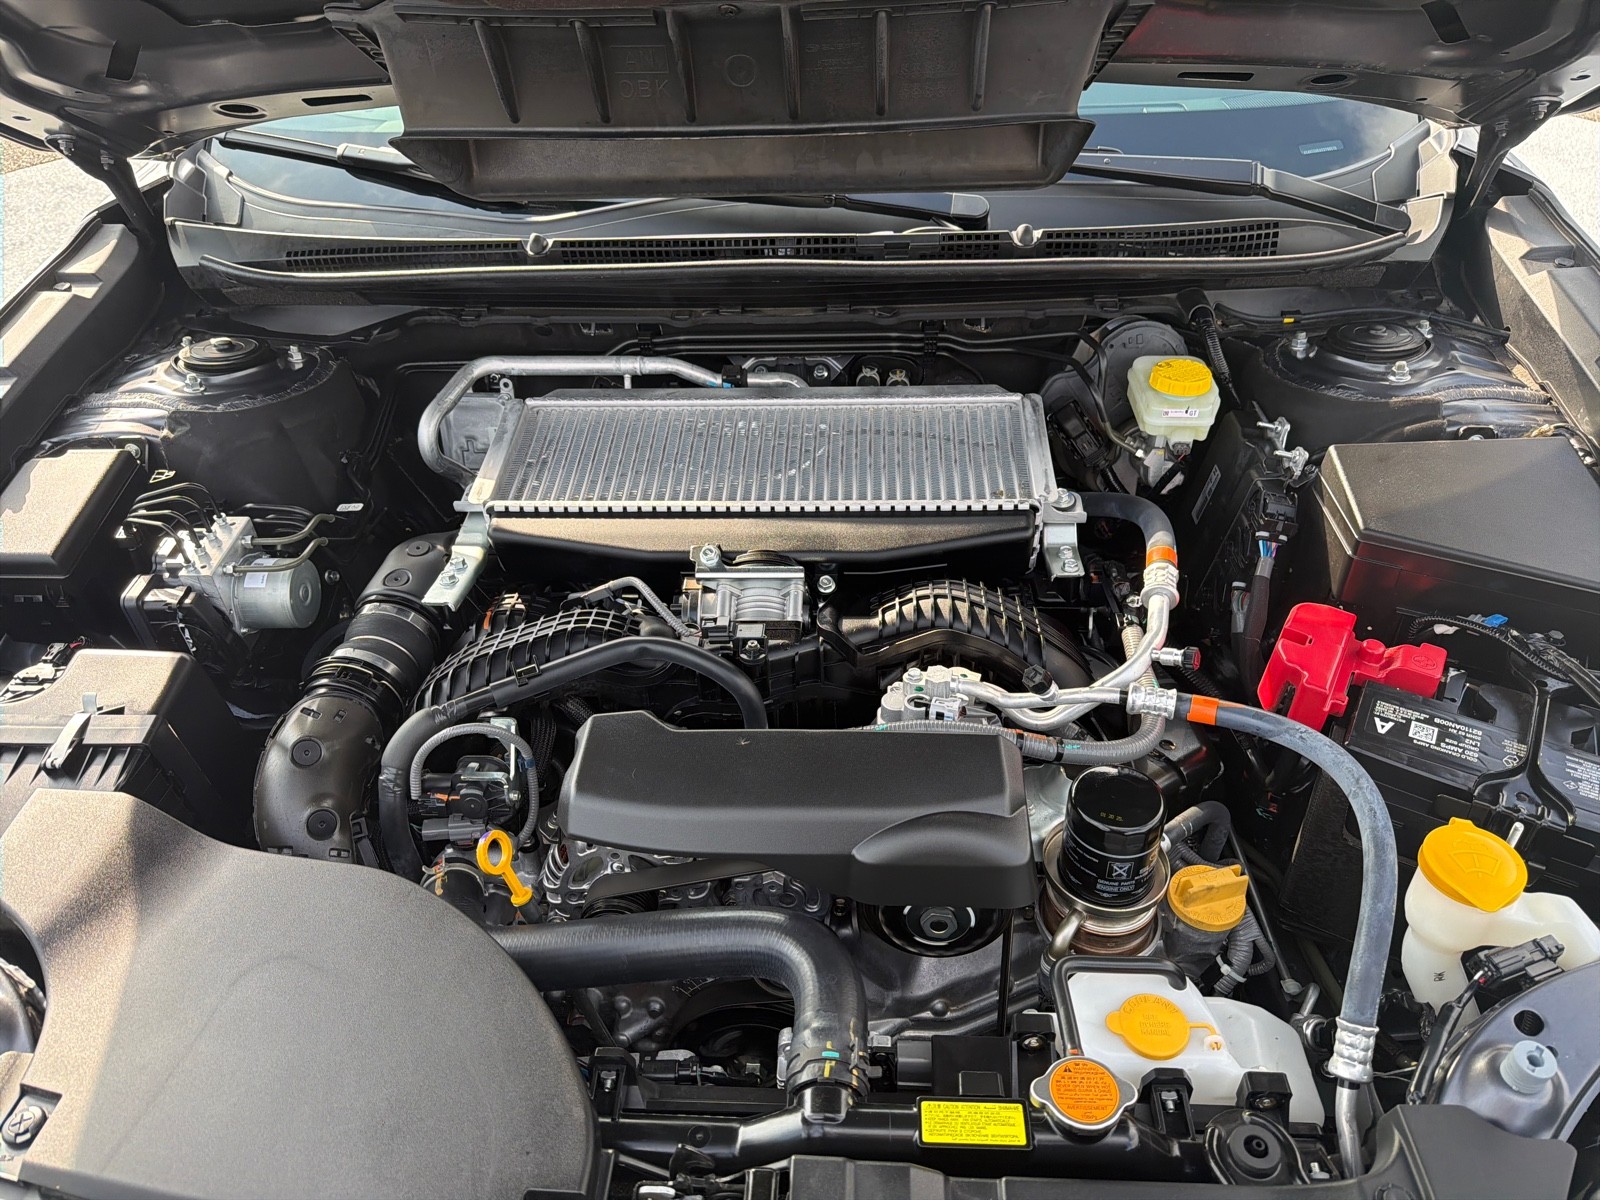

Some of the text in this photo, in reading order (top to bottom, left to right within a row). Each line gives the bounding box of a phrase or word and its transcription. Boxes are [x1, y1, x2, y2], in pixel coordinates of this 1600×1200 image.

[1458, 741, 1480, 752] GROUP
[1464, 738, 1481, 747] LN2
[1413, 739, 1478, 762] COLD CRANKING AMPS
[1440, 742, 1478, 758] 620 AMPS
[1096, 884, 1118, 892] ENGINE
[1123, 995, 1178, 1015] COOLANT
